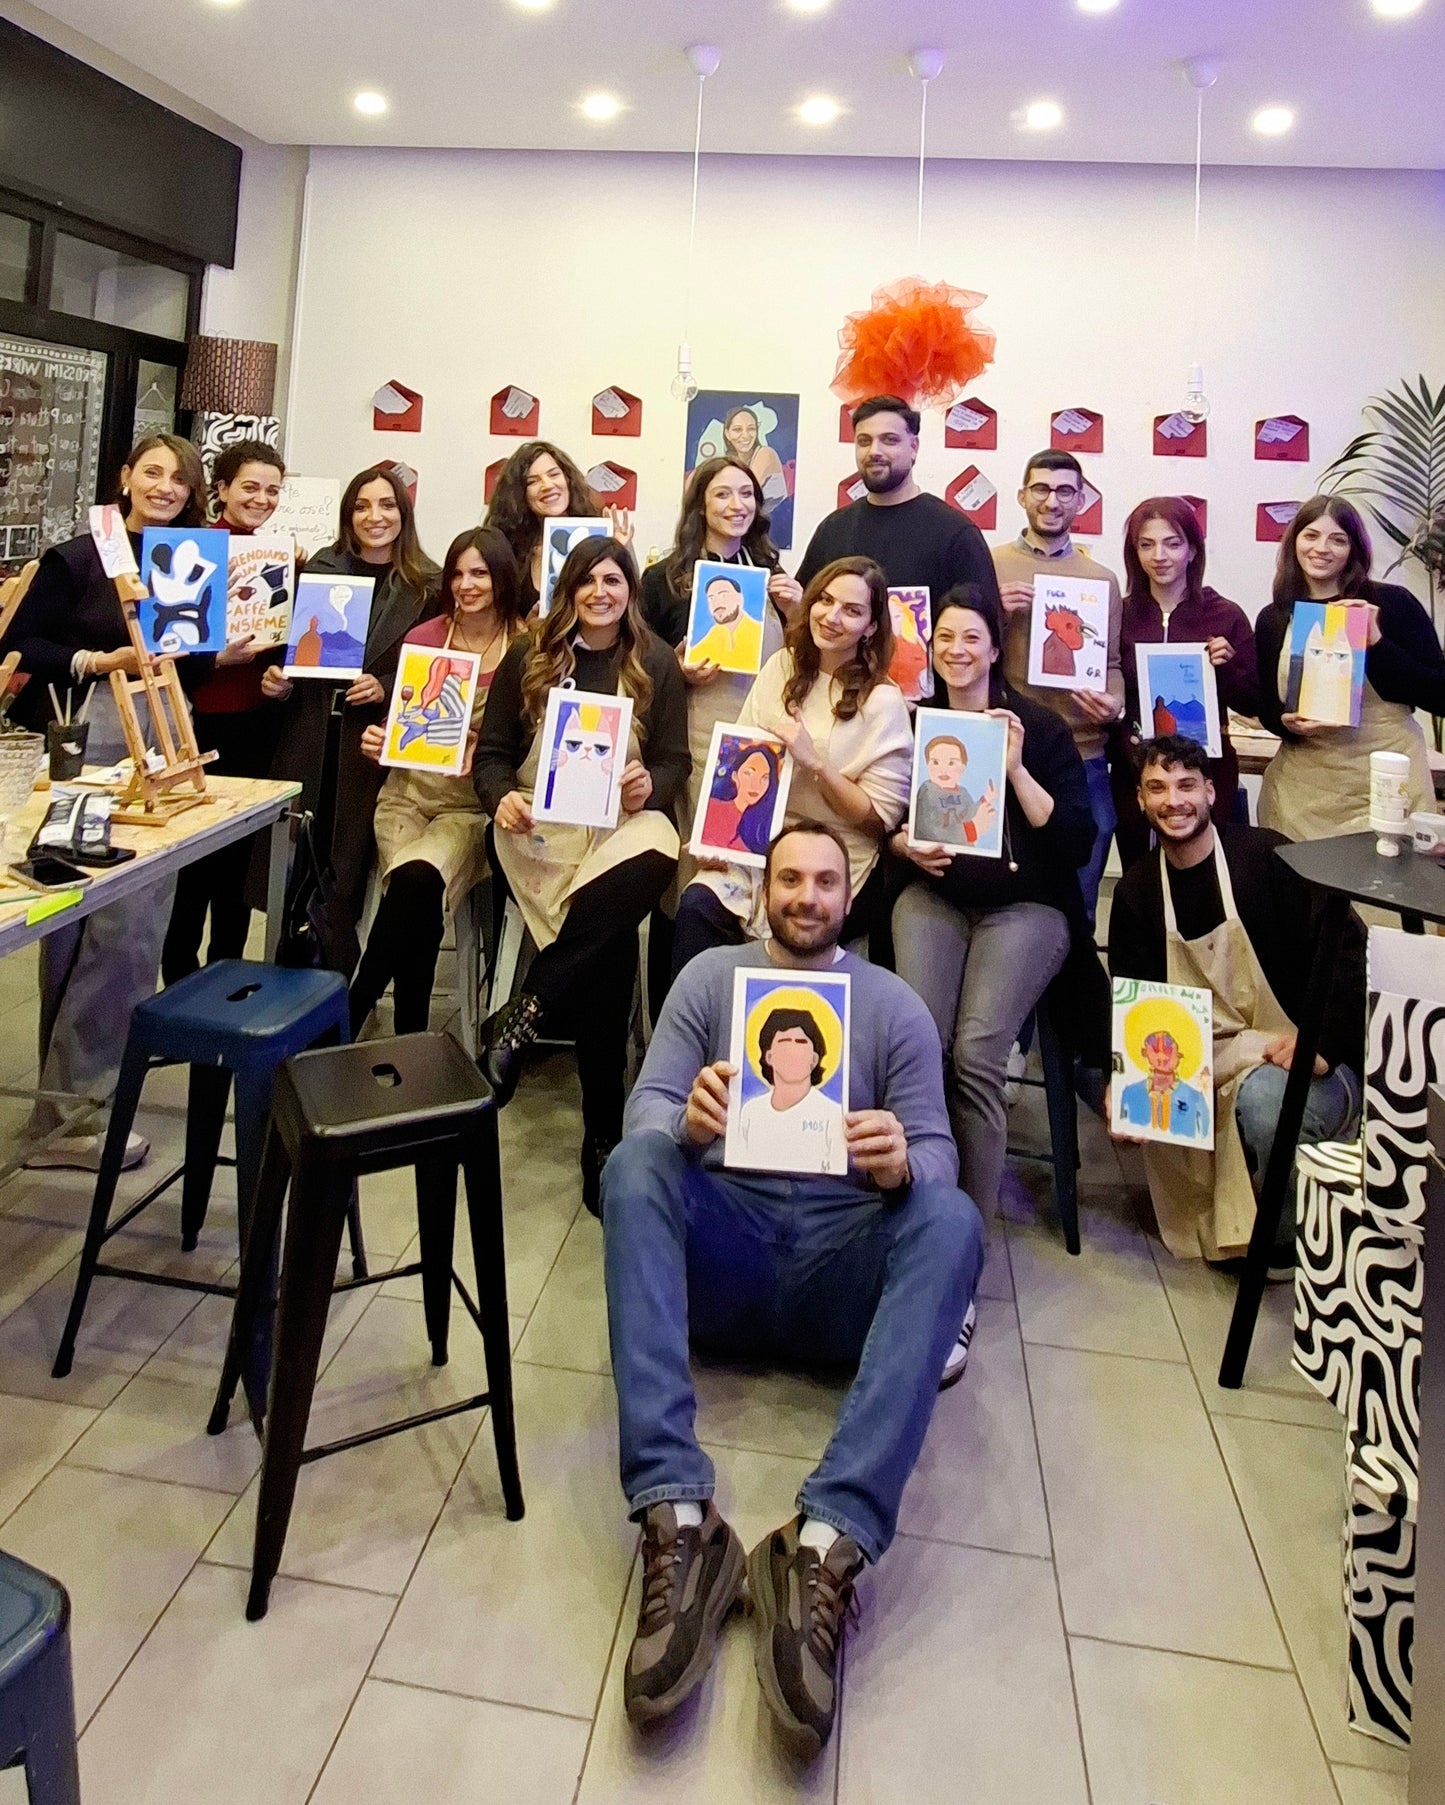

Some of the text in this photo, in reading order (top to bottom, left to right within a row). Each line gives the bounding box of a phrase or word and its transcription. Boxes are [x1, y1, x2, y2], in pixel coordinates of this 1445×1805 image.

[228, 549, 289, 567] RENDIAMO
[227, 599, 267, 616] AFFÈ
[229, 615, 288, 633] NSIEME
